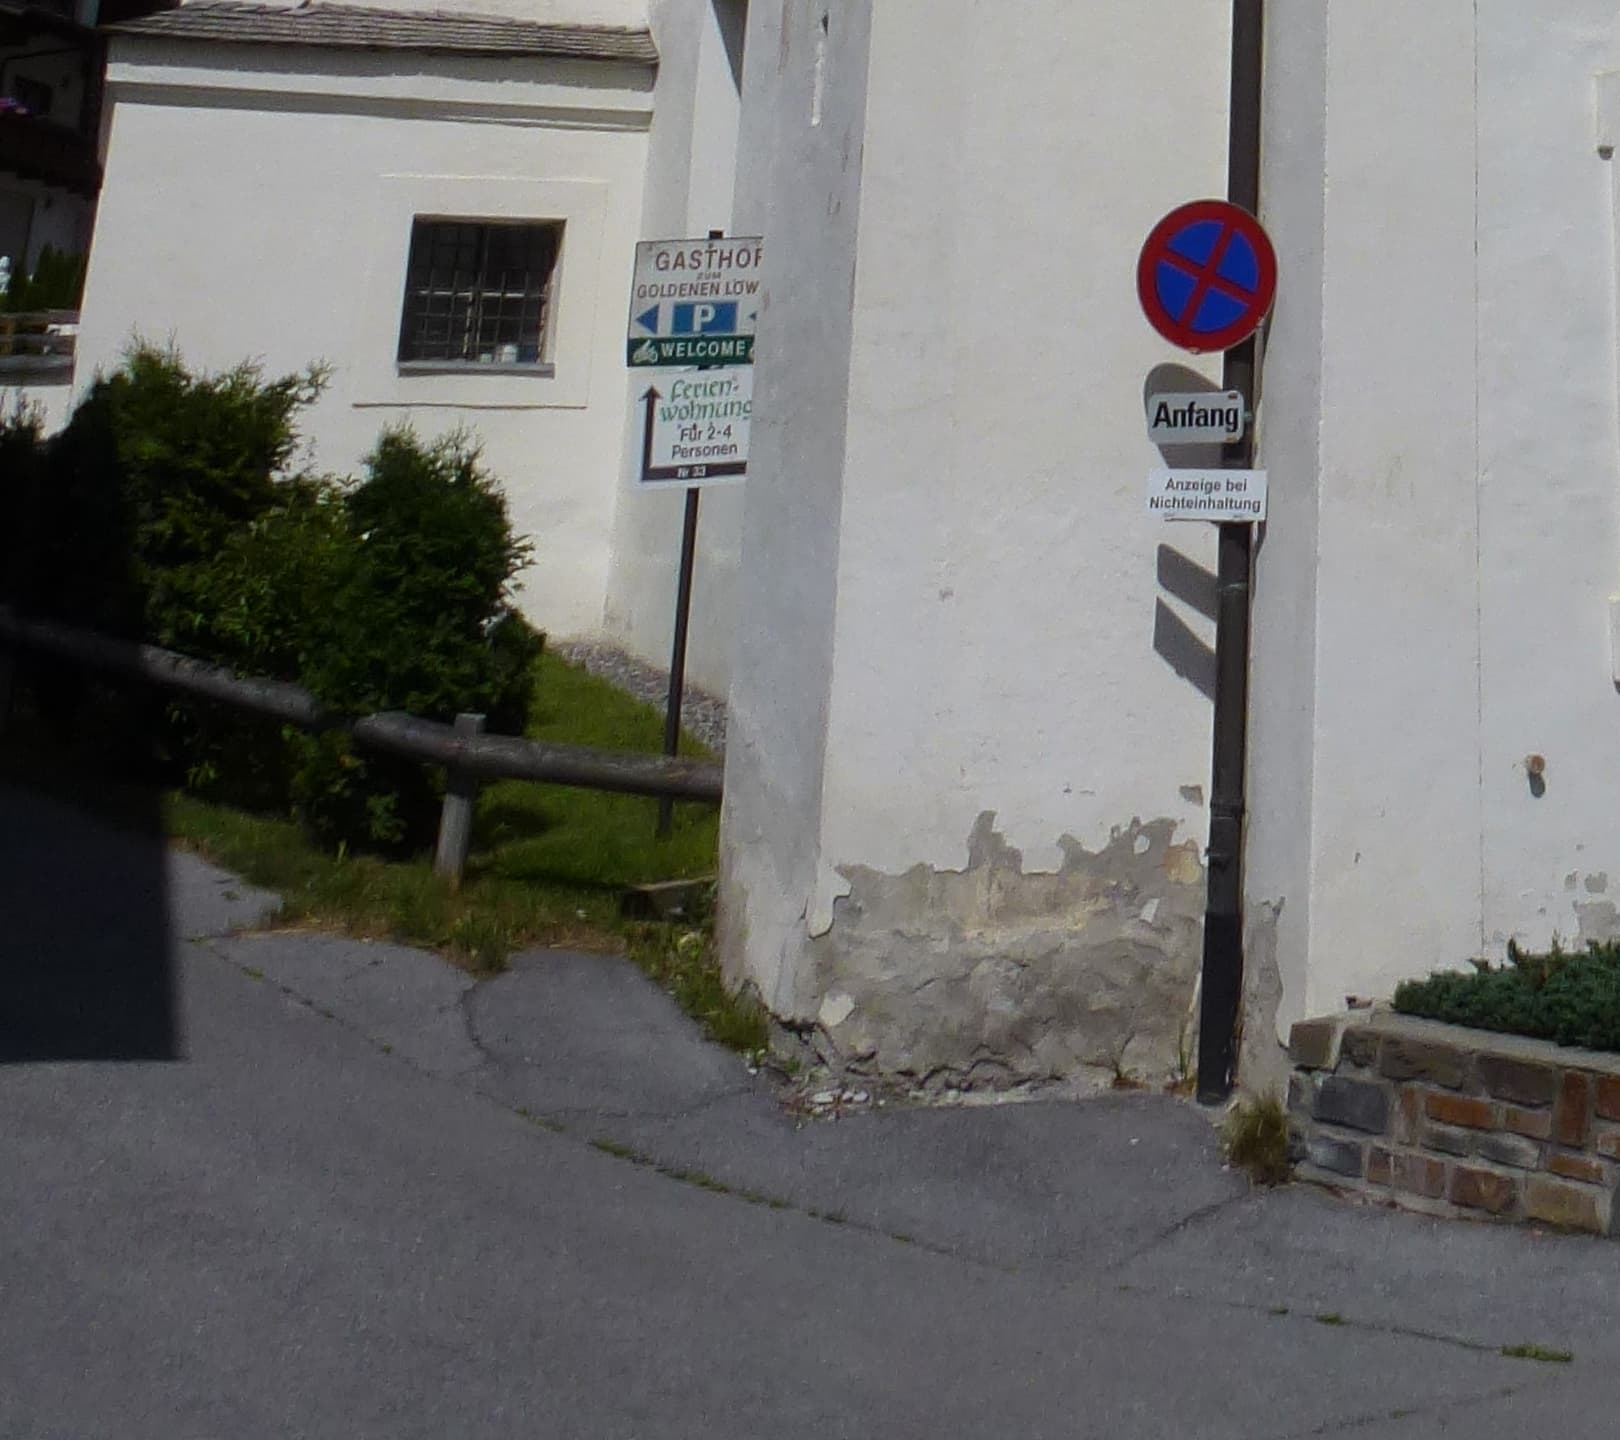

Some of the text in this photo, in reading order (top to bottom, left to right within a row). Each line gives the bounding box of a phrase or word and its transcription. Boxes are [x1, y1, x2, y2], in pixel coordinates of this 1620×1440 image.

[655, 247, 762, 271] GASTHOF
[637, 281, 719, 298] GOLDENEN
[693, 304, 716, 332] P
[661, 339, 746, 358] WELCOME
[1152, 400, 1239, 433] Anfang
[707, 423, 732, 441] 2-4
[671, 443, 738, 459] Personen
[1164, 477, 1248, 495] Anzeige bei
[1149, 495, 1262, 513] Nichteinhaltung
